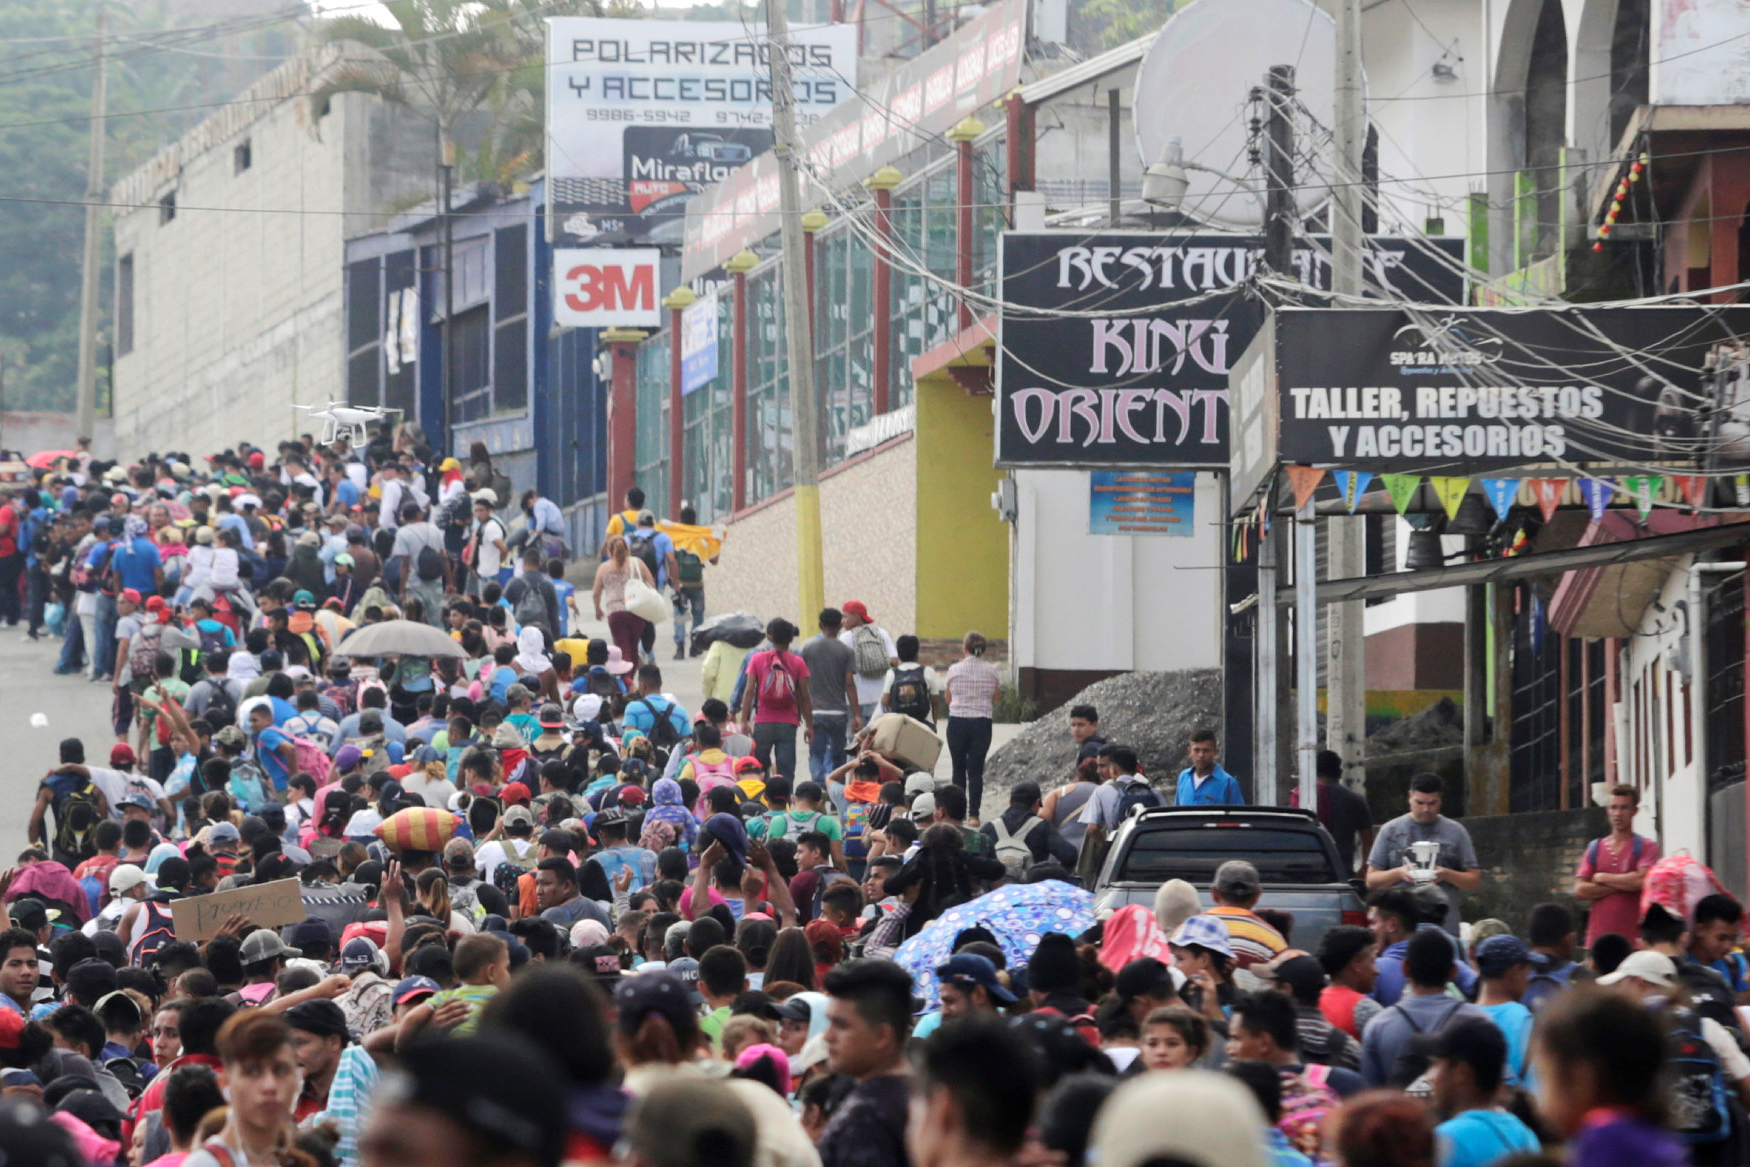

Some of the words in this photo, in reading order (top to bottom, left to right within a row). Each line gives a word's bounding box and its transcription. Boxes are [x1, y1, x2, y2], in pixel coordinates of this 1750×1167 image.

[568, 75, 591, 99] Y
[564, 264, 655, 312] 3M
[1089, 318, 1231, 377] KING
[1289, 386, 1410, 423] TALLER,
[1415, 385, 1605, 419] REPUESTOS
[1327, 424, 1351, 458] Y
[1354, 424, 1567, 459] ACCESORIOS
